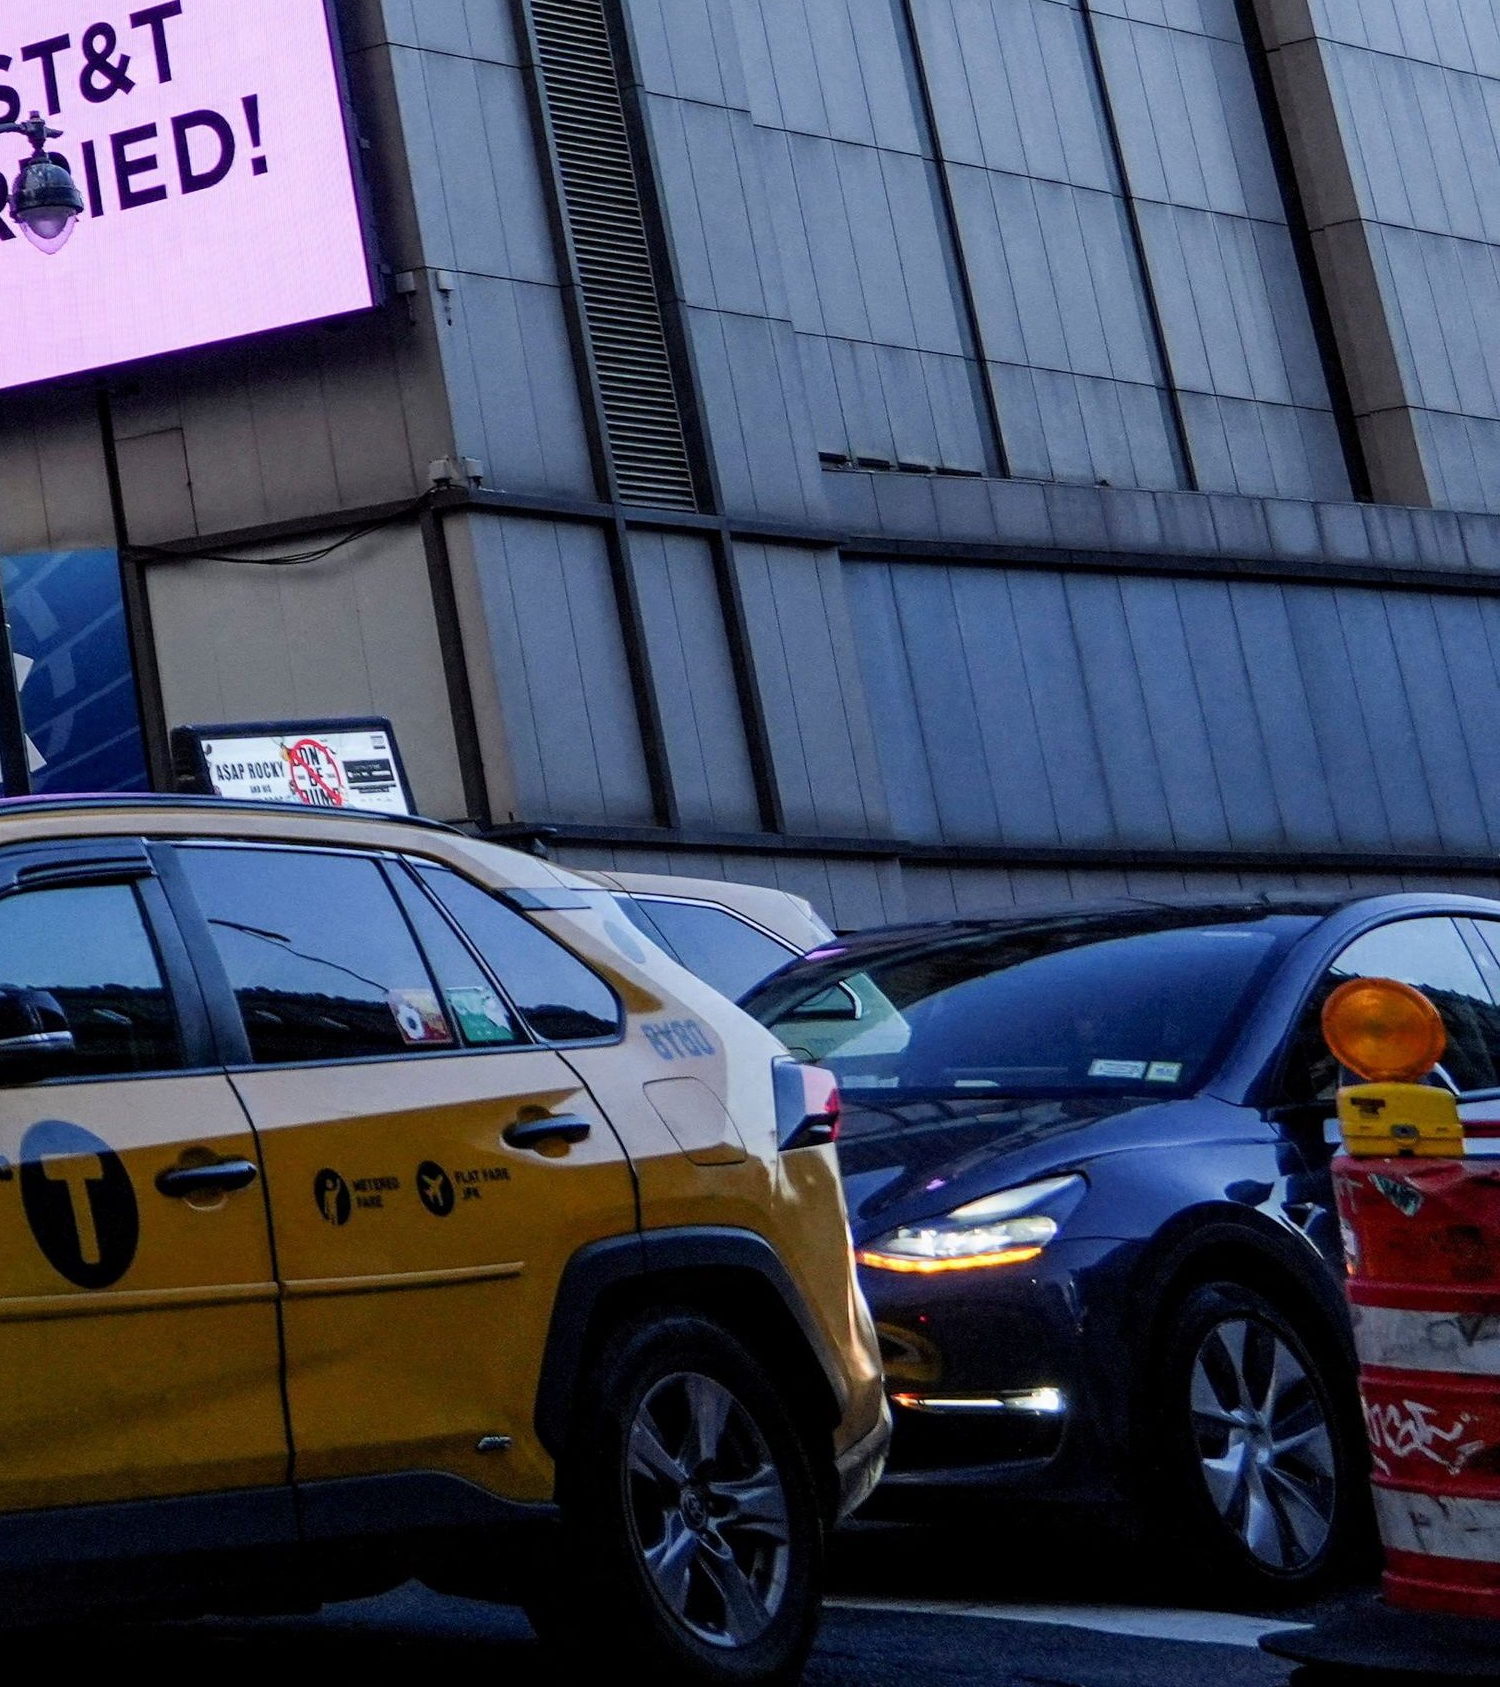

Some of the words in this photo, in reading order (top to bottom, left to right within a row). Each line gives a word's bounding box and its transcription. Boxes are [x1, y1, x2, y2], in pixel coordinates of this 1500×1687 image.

[249, 760, 285, 780] ROCKY
[641, 1019, 716, 1061] 8Y80
[454, 1170, 480, 1185] FLAT
[483, 1167, 511, 1182] FARE
[352, 1177, 399, 1194] METERED
[461, 1186, 482, 1201] JFK
[40, 1152, 103, 1266] T
[356, 1194, 384, 1209] FARE
